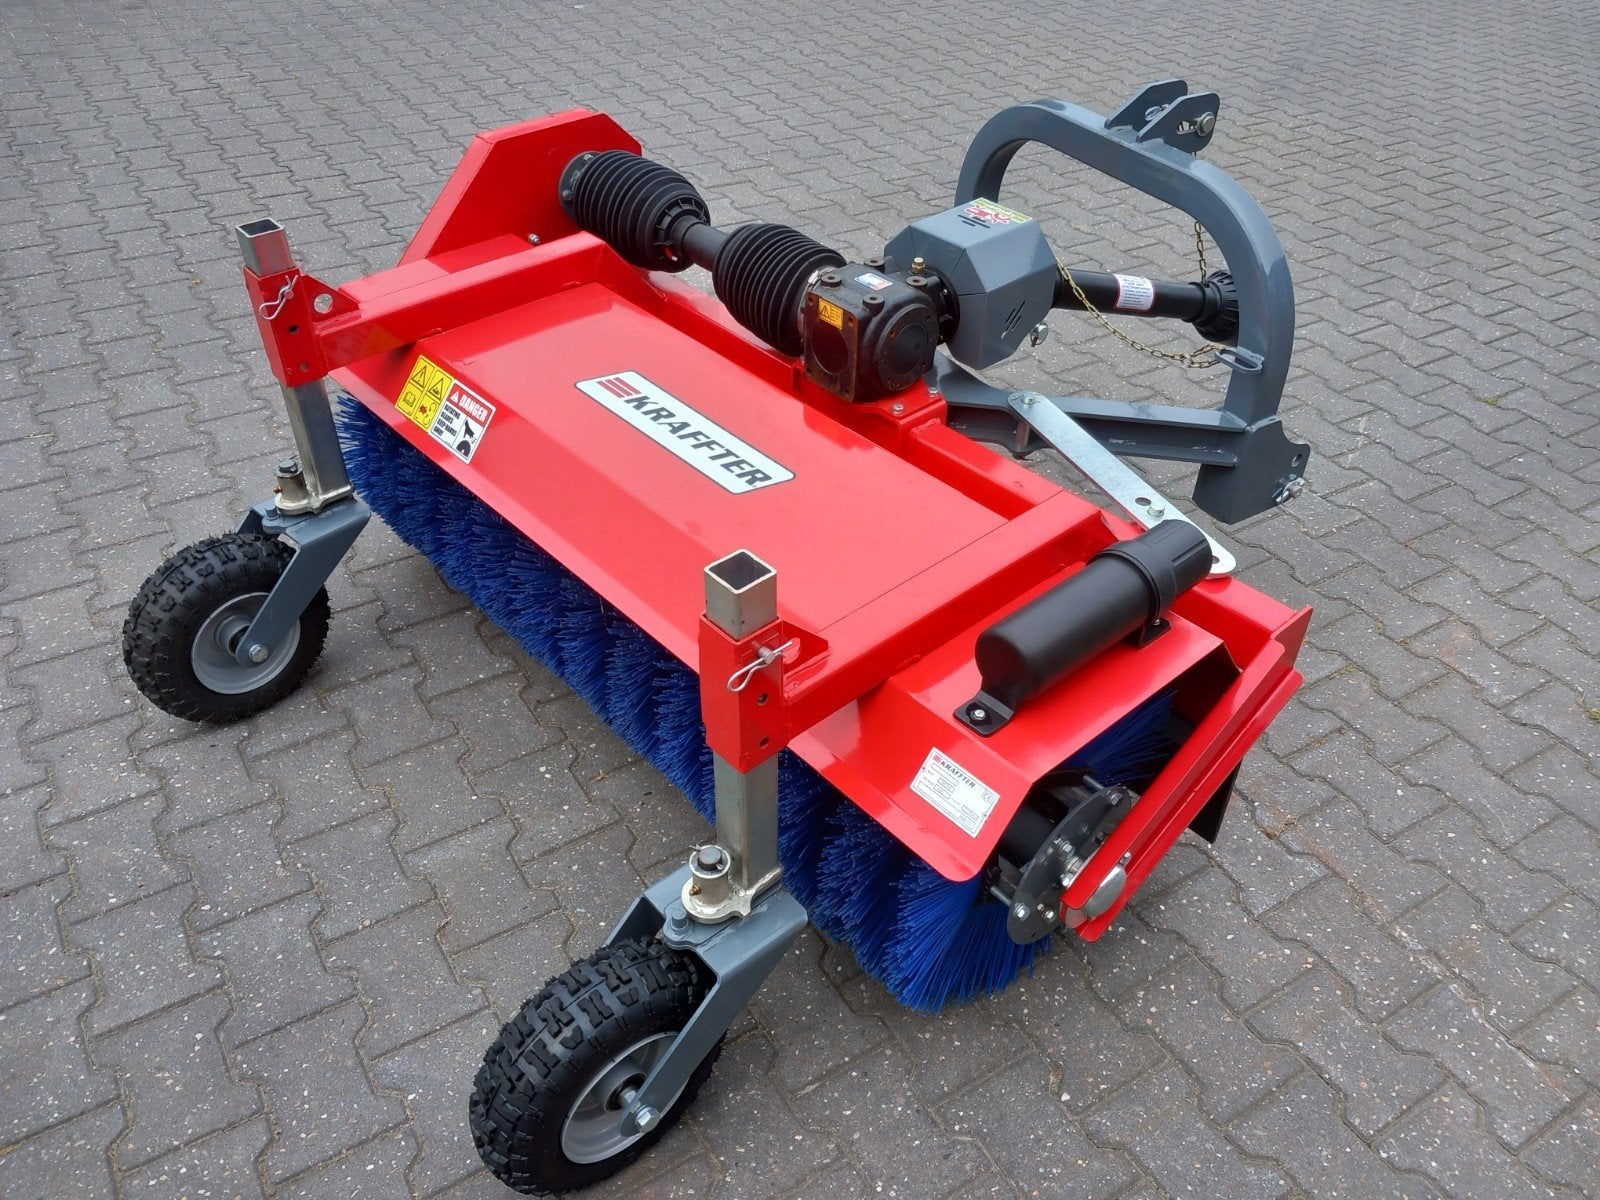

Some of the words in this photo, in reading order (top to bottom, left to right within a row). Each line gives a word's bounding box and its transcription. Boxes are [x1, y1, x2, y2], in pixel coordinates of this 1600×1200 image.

[459, 394, 488, 423] DANGER
[437, 419, 447, 429] KEEP
[445, 424, 457, 437] HANDS
[624, 395, 773, 486] KRAFFTER
[940, 761, 976, 788] KRAFFTER
